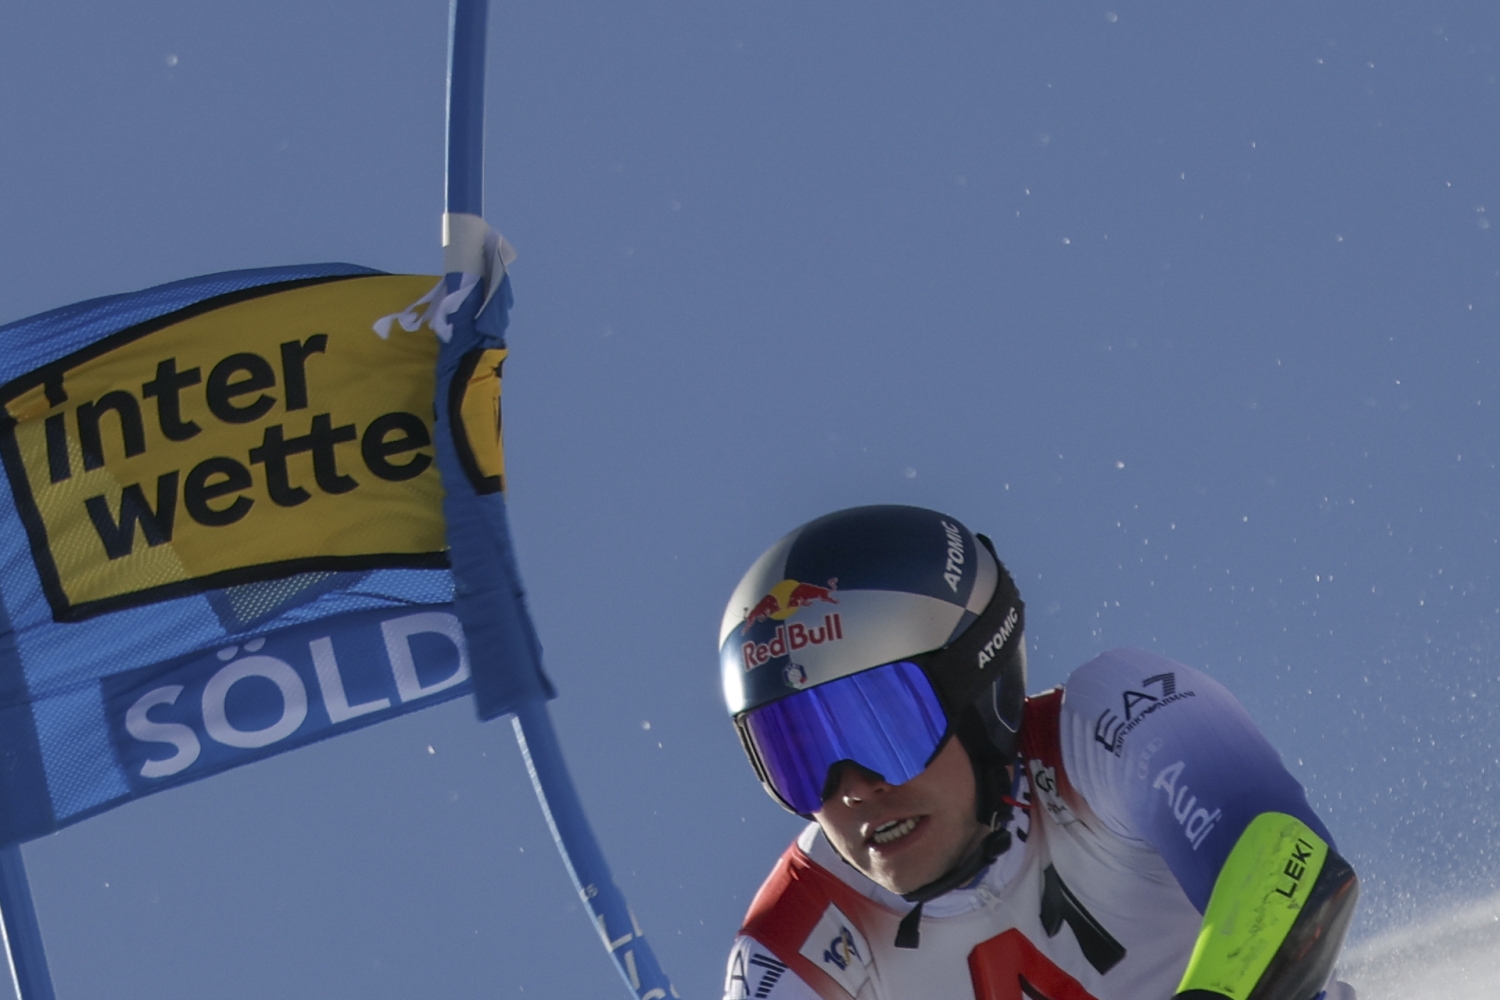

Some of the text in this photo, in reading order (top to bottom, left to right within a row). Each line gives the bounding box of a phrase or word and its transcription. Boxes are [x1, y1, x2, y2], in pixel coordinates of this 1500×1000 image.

[45, 333, 328, 484] inter
[84, 411, 438, 561] wette
[942, 520, 965, 592] ATOMIC
[741, 613, 844, 672] Red Bull
[977, 606, 1019, 669] ATOMIC
[125, 611, 470, 778] SÖLD
[1095, 672, 1176, 752] EA7
[1153, 760, 1222, 851] Audi
[1275, 838, 1314, 899] LEKI
[729, 950, 788, 999] A7
